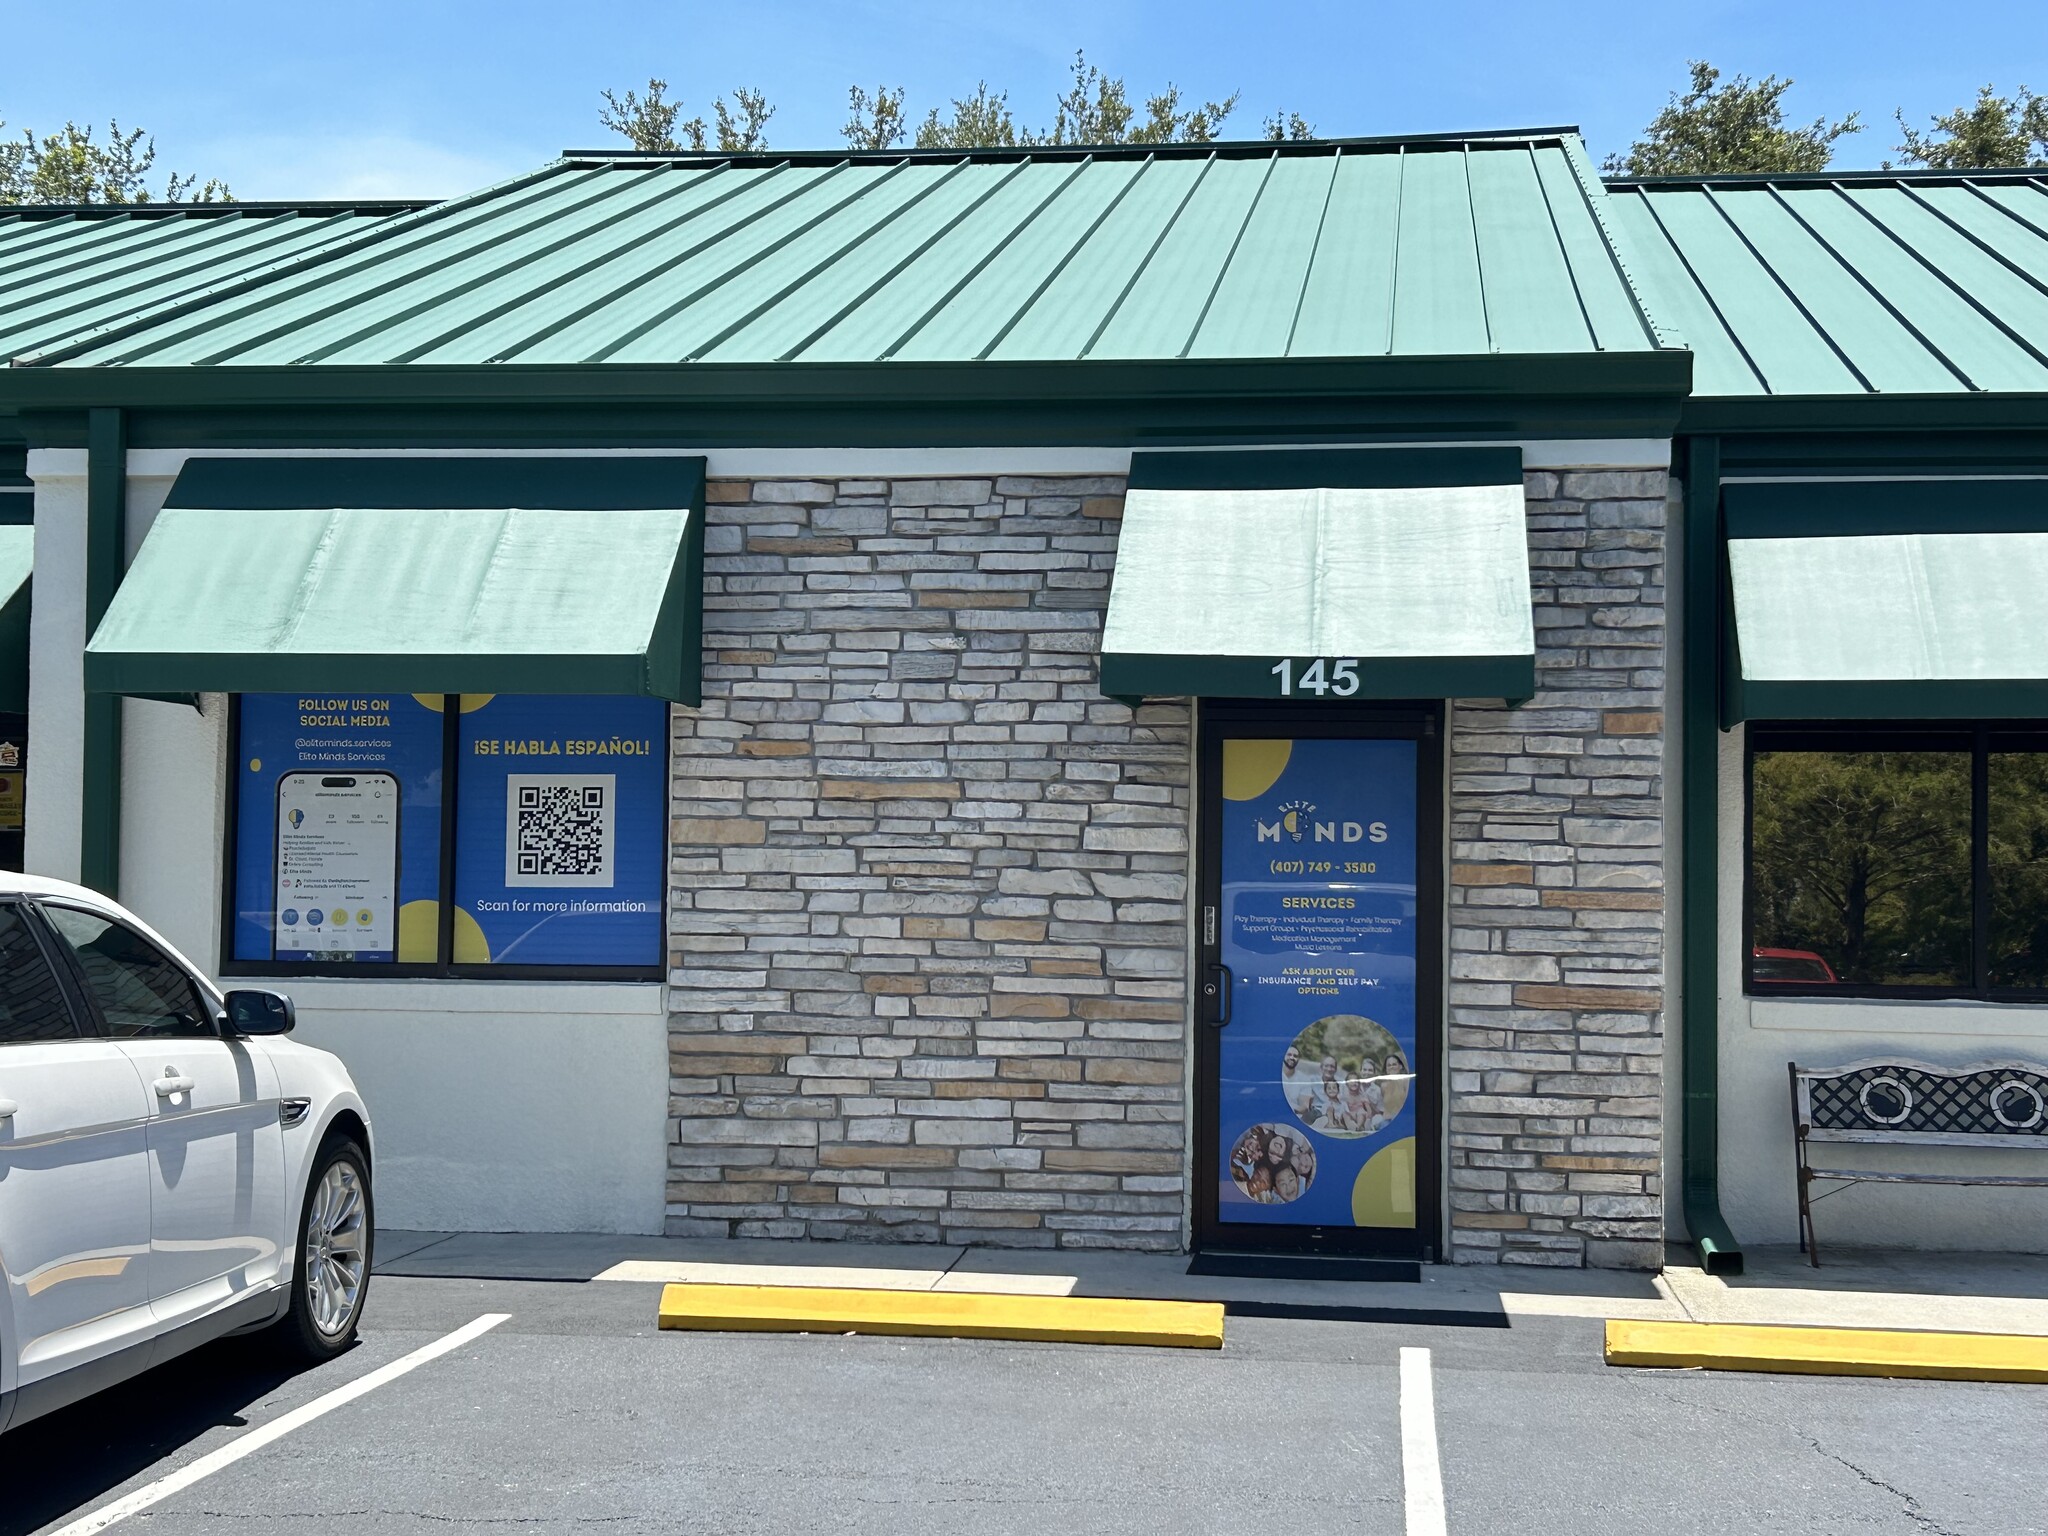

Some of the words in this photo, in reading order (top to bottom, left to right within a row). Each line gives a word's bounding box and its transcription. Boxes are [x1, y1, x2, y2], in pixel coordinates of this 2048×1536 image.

[1271, 658, 1360, 696] 145
[298, 699, 348, 711] FOLLOW
[351, 699, 368, 711] US
[370, 699, 390, 711] ON
[300, 715, 347, 727] SOCIAL
[350, 715, 390, 727] MEDIA
[504, 740, 561, 755] HABLA
[565, 736, 650, 755] ESPAÑOL!
[298, 752, 317, 761] Elite
[318, 752, 346, 761] Minds
[347, 752, 386, 761] Services
[1277, 800, 1317, 813] ELITE
[1270, 860, 1304, 875] (407)
[1307, 862, 1331, 873] 749
[477, 899, 510, 912] Scan
[512, 899, 530, 912] for
[533, 901, 568, 912] more
[570, 899, 646, 912] information
[1282, 897, 1356, 909] SERVICES
[1250, 915, 1277, 923] Therapy
[1316, 916, 1345, 924] Therapy
[1242, 924, 1269, 933] Support
[1270, 925, 1295, 933] Groups
[1310, 936, 1356, 944] Management
[1281, 968, 1301, 976] ASK
[1302, 968, 1333, 976] ABOUT
[1335, 968, 1355, 976] OUR
[1258, 976, 1312, 985] INSURANCE
[1338, 978, 1359, 986] SELF
[1360, 978, 1380, 986] PAY
[1297, 987, 1340, 995] OPTIONS
